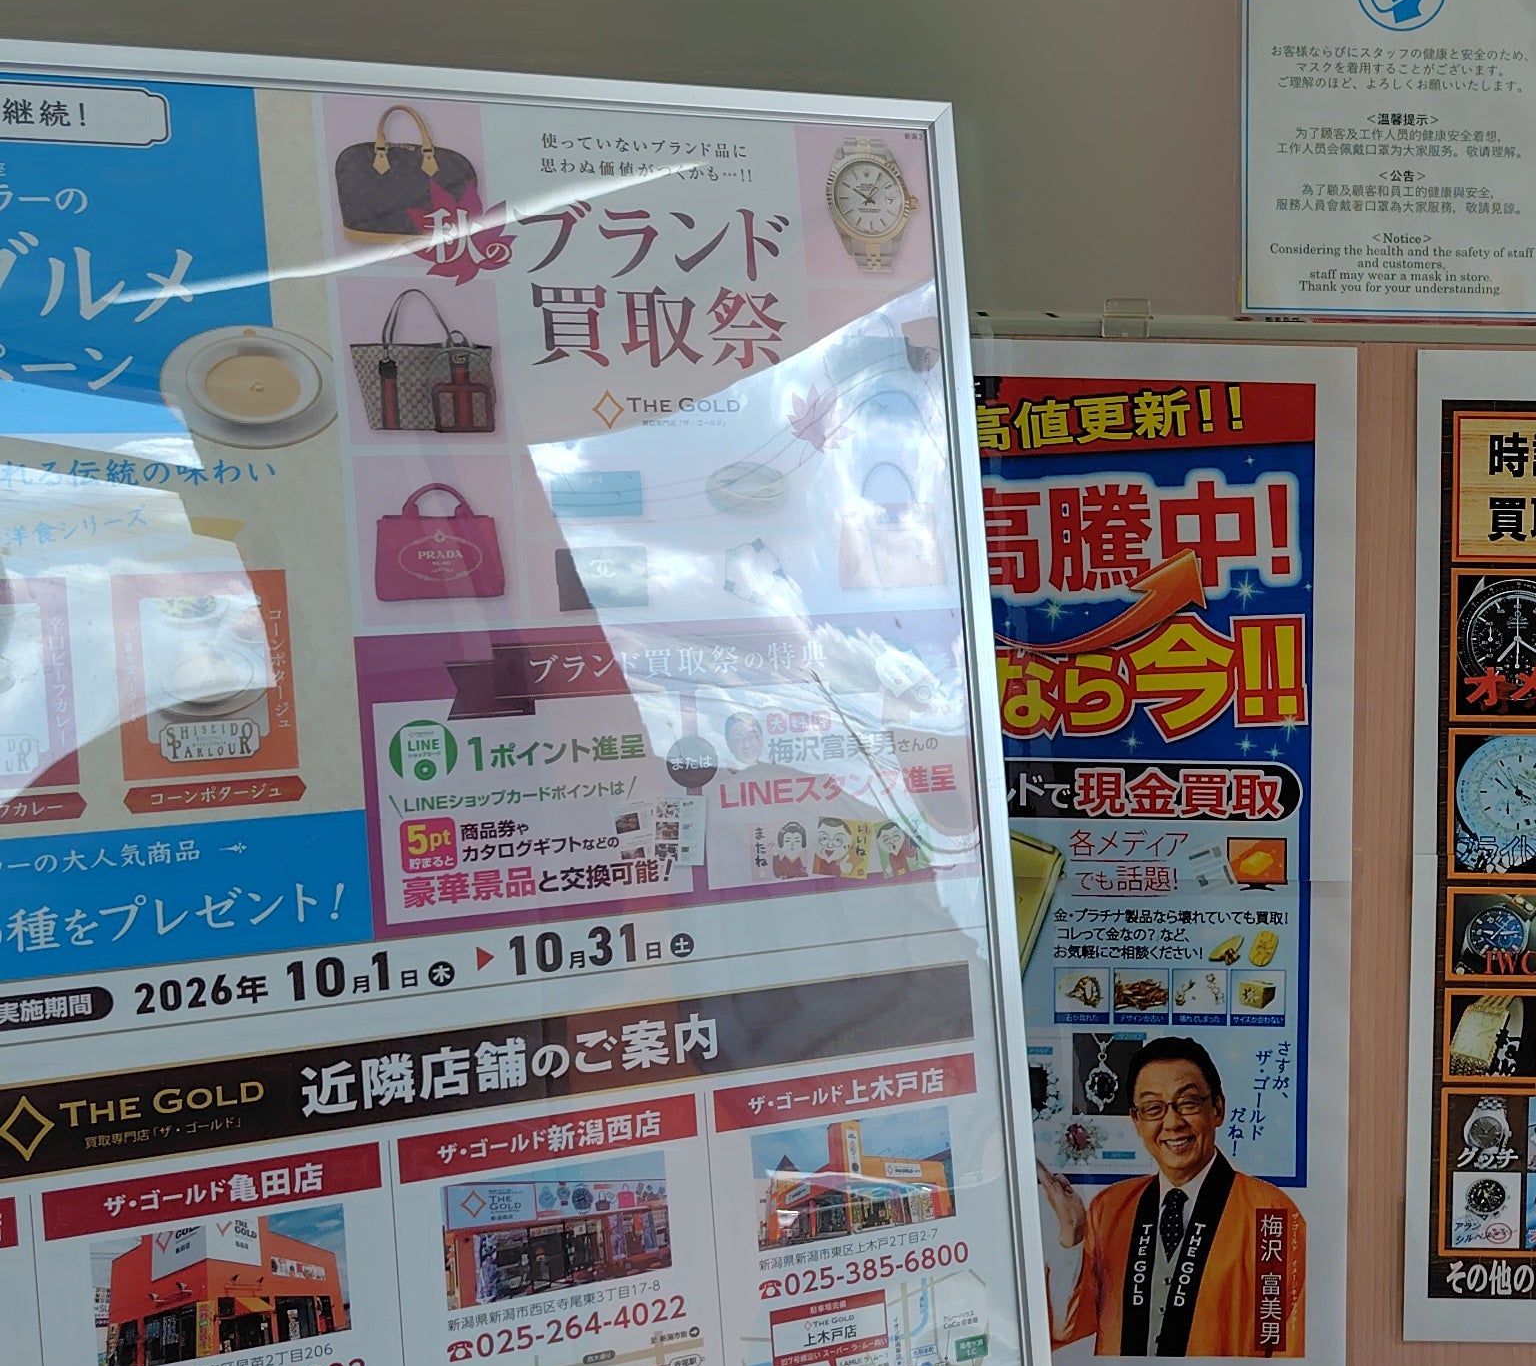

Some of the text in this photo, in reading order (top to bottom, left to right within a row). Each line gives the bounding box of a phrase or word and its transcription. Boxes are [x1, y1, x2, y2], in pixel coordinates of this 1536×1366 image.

[1270, 45, 1530, 63] お客様ならびにスタッフの健康と安全のため、
[1296, 61, 1505, 78] マスクを着用することがございます。
[1278, 76, 1524, 93] ご理解のほど、よろしくお願いいたします。
[540, 132, 748, 160] 使っていないブランド品に
[1270, 243, 1535, 260] Considering the health and the safety of staff
[1357, 258, 1379, 269] and
[1299, 280, 1337, 292] Thank
[1340, 283, 1362, 294] you
[1365, 281, 1381, 293] for
[1384, 284, 1411, 295] your
[1309, 269, 1338, 280] staff
[1339, 271, 1365, 283] may
[1367, 272, 1397, 282] wear
[1410, 271, 1442, 283] mask
[530, 282, 788, 370] 買取祭
[626, 396, 741, 415] THE GOLD
[417, 548, 465, 561] PRADA
[268, 608, 292, 729] コーンポタージュ
[529, 640, 830, 685] ブランド買取祭の特典
[165, 721, 254, 743] SHISEIDO
[407, 739, 440, 752] LINE
[171, 735, 253, 761] PARLOUR
[467, 733, 647, 772] 1ポイント進呈
[671, 754, 713, 771] または
[150, 782, 282, 806] コーンポタージュ
[404, 780, 625, 813] LINEショップカードポイントは
[1008, 767, 1285, 819] ドで現金買取
[407, 823, 452, 855] 5pt
[460, 819, 529, 842] 商品券や
[1070, 829, 1190, 857] 各メディア
[462, 836, 620, 864] カタログギフトなどの
[754, 826, 768, 868] またね
[409, 855, 455, 870] 貯まると
[1076, 865, 1179, 892] でも話題!
[1054, 944, 1204, 961] お気軽にご相談ください!
[134, 974, 268, 1015] 2026年
[0, 993, 92, 1025] 実施期間
[301, 1011, 719, 1118] 近隣店舗のご案内
[59, 1081, 265, 1127] THE GOLD
[749, 1068, 944, 1115] ザ・ゴールド上木戸店
[85, 1117, 242, 1149] 買取専門店「ザ・ゴールド」
[438, 1111, 661, 1164] ザ・ゴールド新潟西店
[1457, 1147, 1518, 1169] グッチ
[103, 1162, 323, 1217] ザ・ゴールド亀田店
[784, 1241, 968, 1296] 025-385-6800
[1132, 1223, 1154, 1307] THE GOLD
[476, 1295, 687, 1357] 025-264-4022
[804, 1325, 857, 1347] 上木戸店
